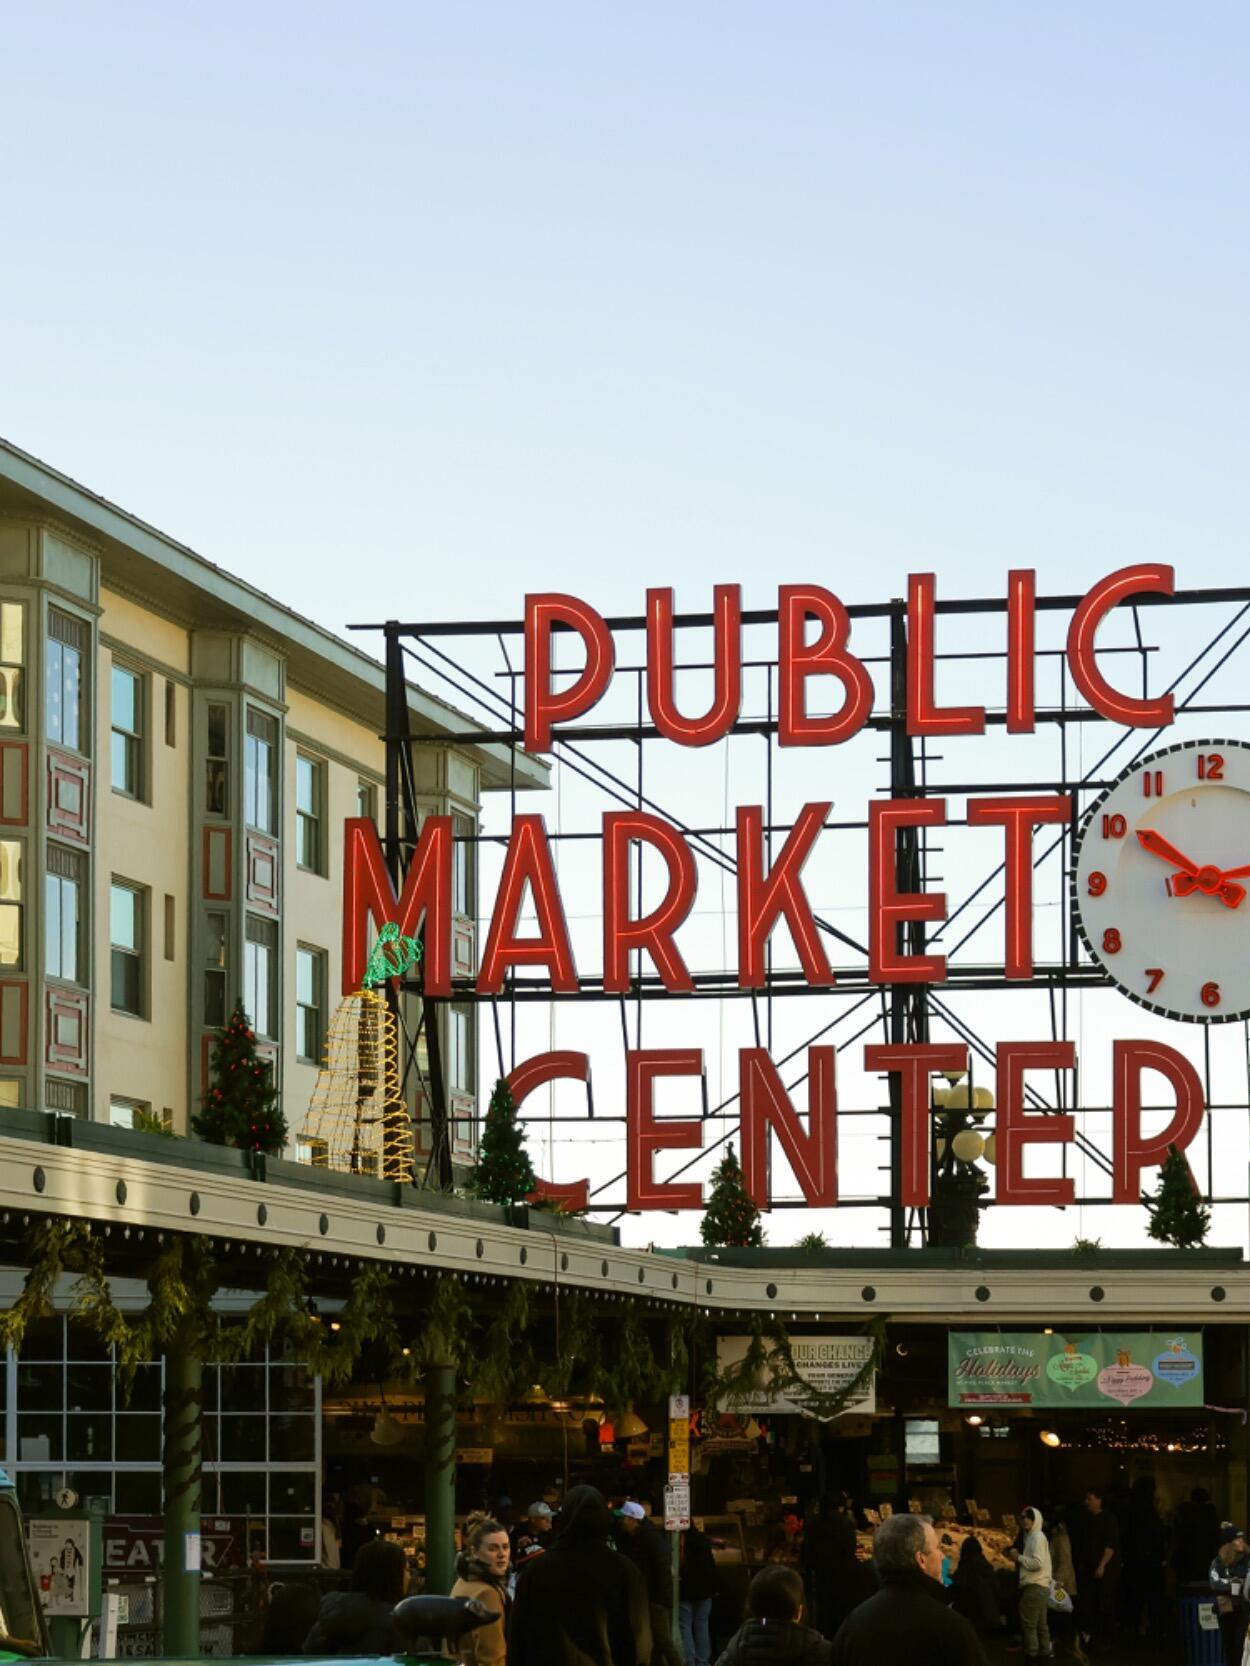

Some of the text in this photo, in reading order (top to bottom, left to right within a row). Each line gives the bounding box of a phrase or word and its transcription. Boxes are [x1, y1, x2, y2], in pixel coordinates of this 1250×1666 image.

[524, 563, 1174, 753] PUBLIC
[1197, 754, 1224, 780] 12
[1102, 813, 1127, 839] 10
[342, 795, 1073, 997] MARKET
[1087, 871, 1107, 897] 9
[1103, 928, 1122, 953] 8
[1145, 968, 1165, 994] 7
[1200, 982, 1221, 1006] 6
[488, 1039, 1205, 1212] CENTER
[792, 1345, 817, 1360] OUR
[841, 1361, 862, 1369] LIVE
